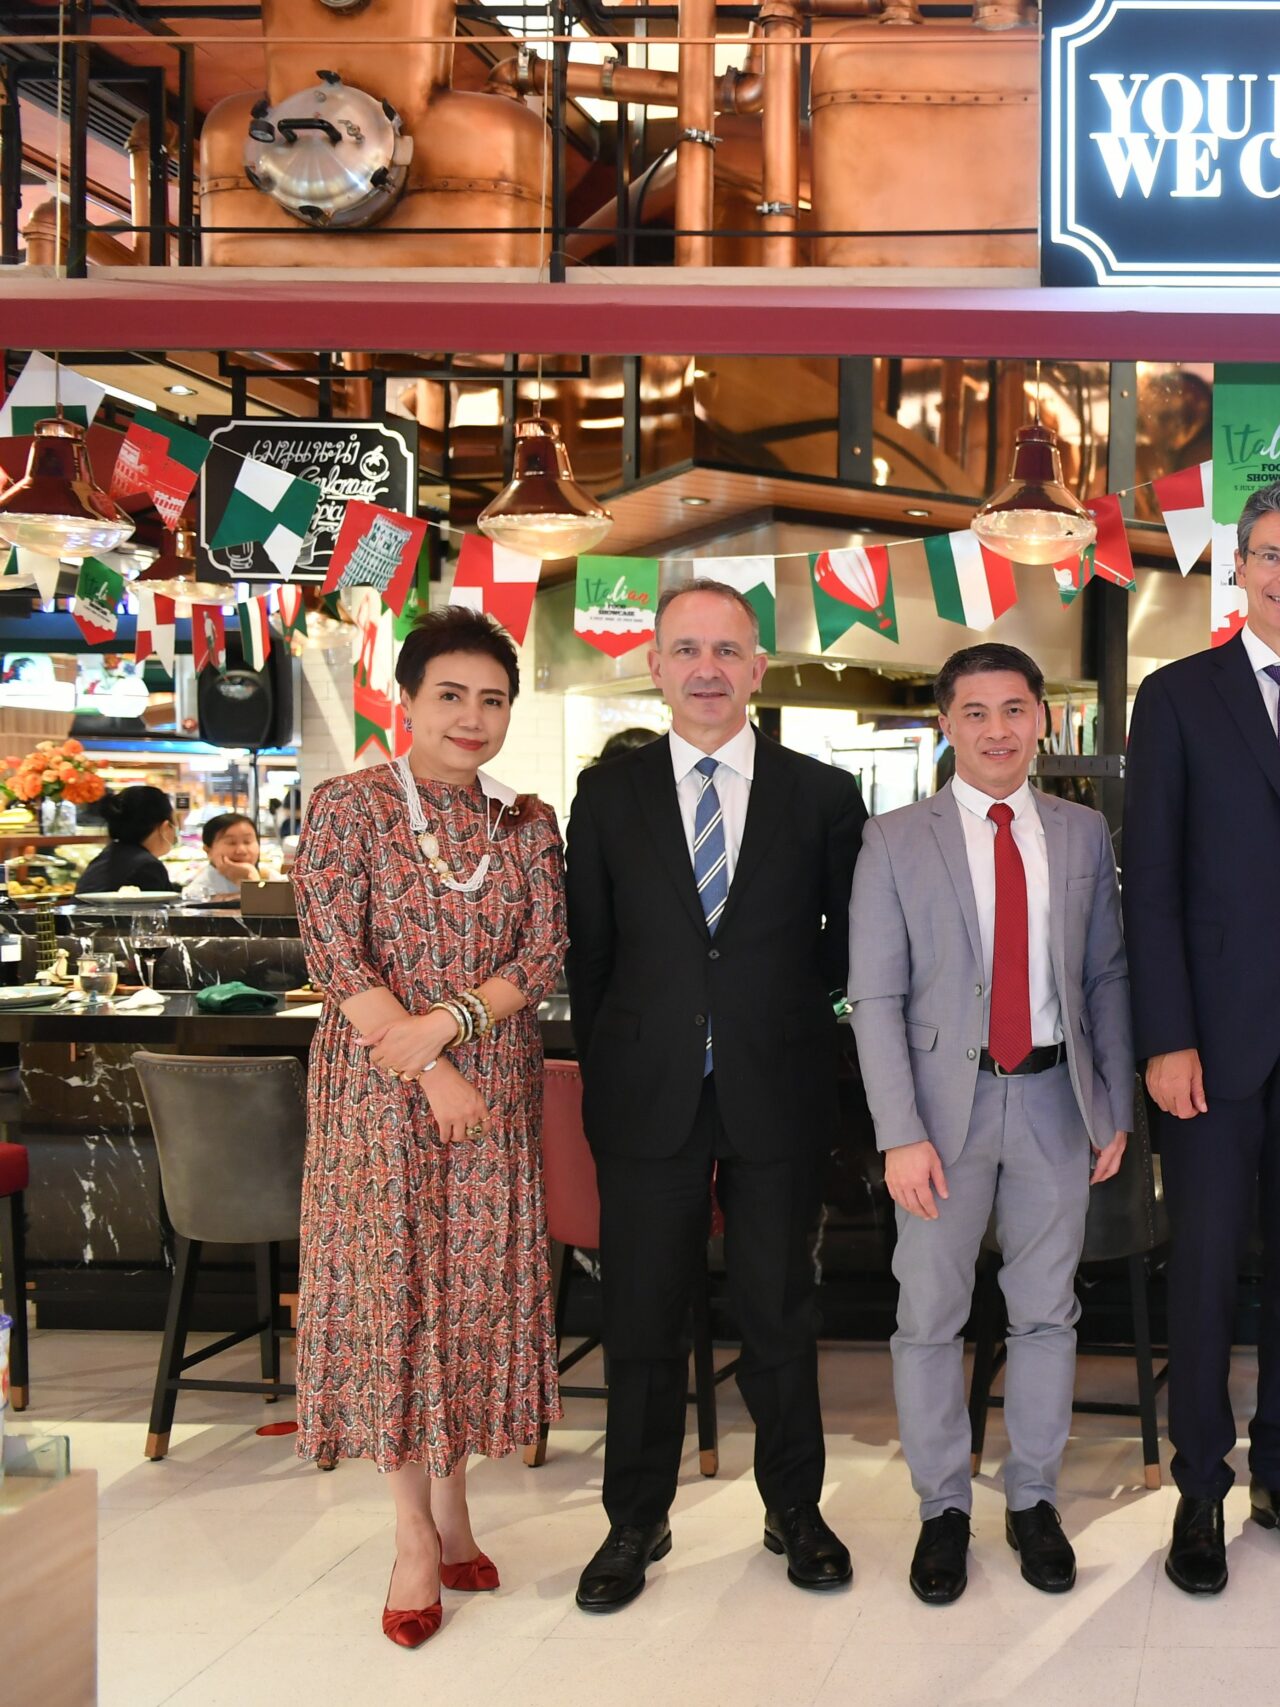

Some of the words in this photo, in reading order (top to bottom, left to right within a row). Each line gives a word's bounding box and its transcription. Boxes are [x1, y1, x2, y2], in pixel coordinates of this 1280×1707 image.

[1089, 72, 1258, 140] YOU
[1089, 132, 1222, 199] WE
[584, 575, 649, 605] Italian
